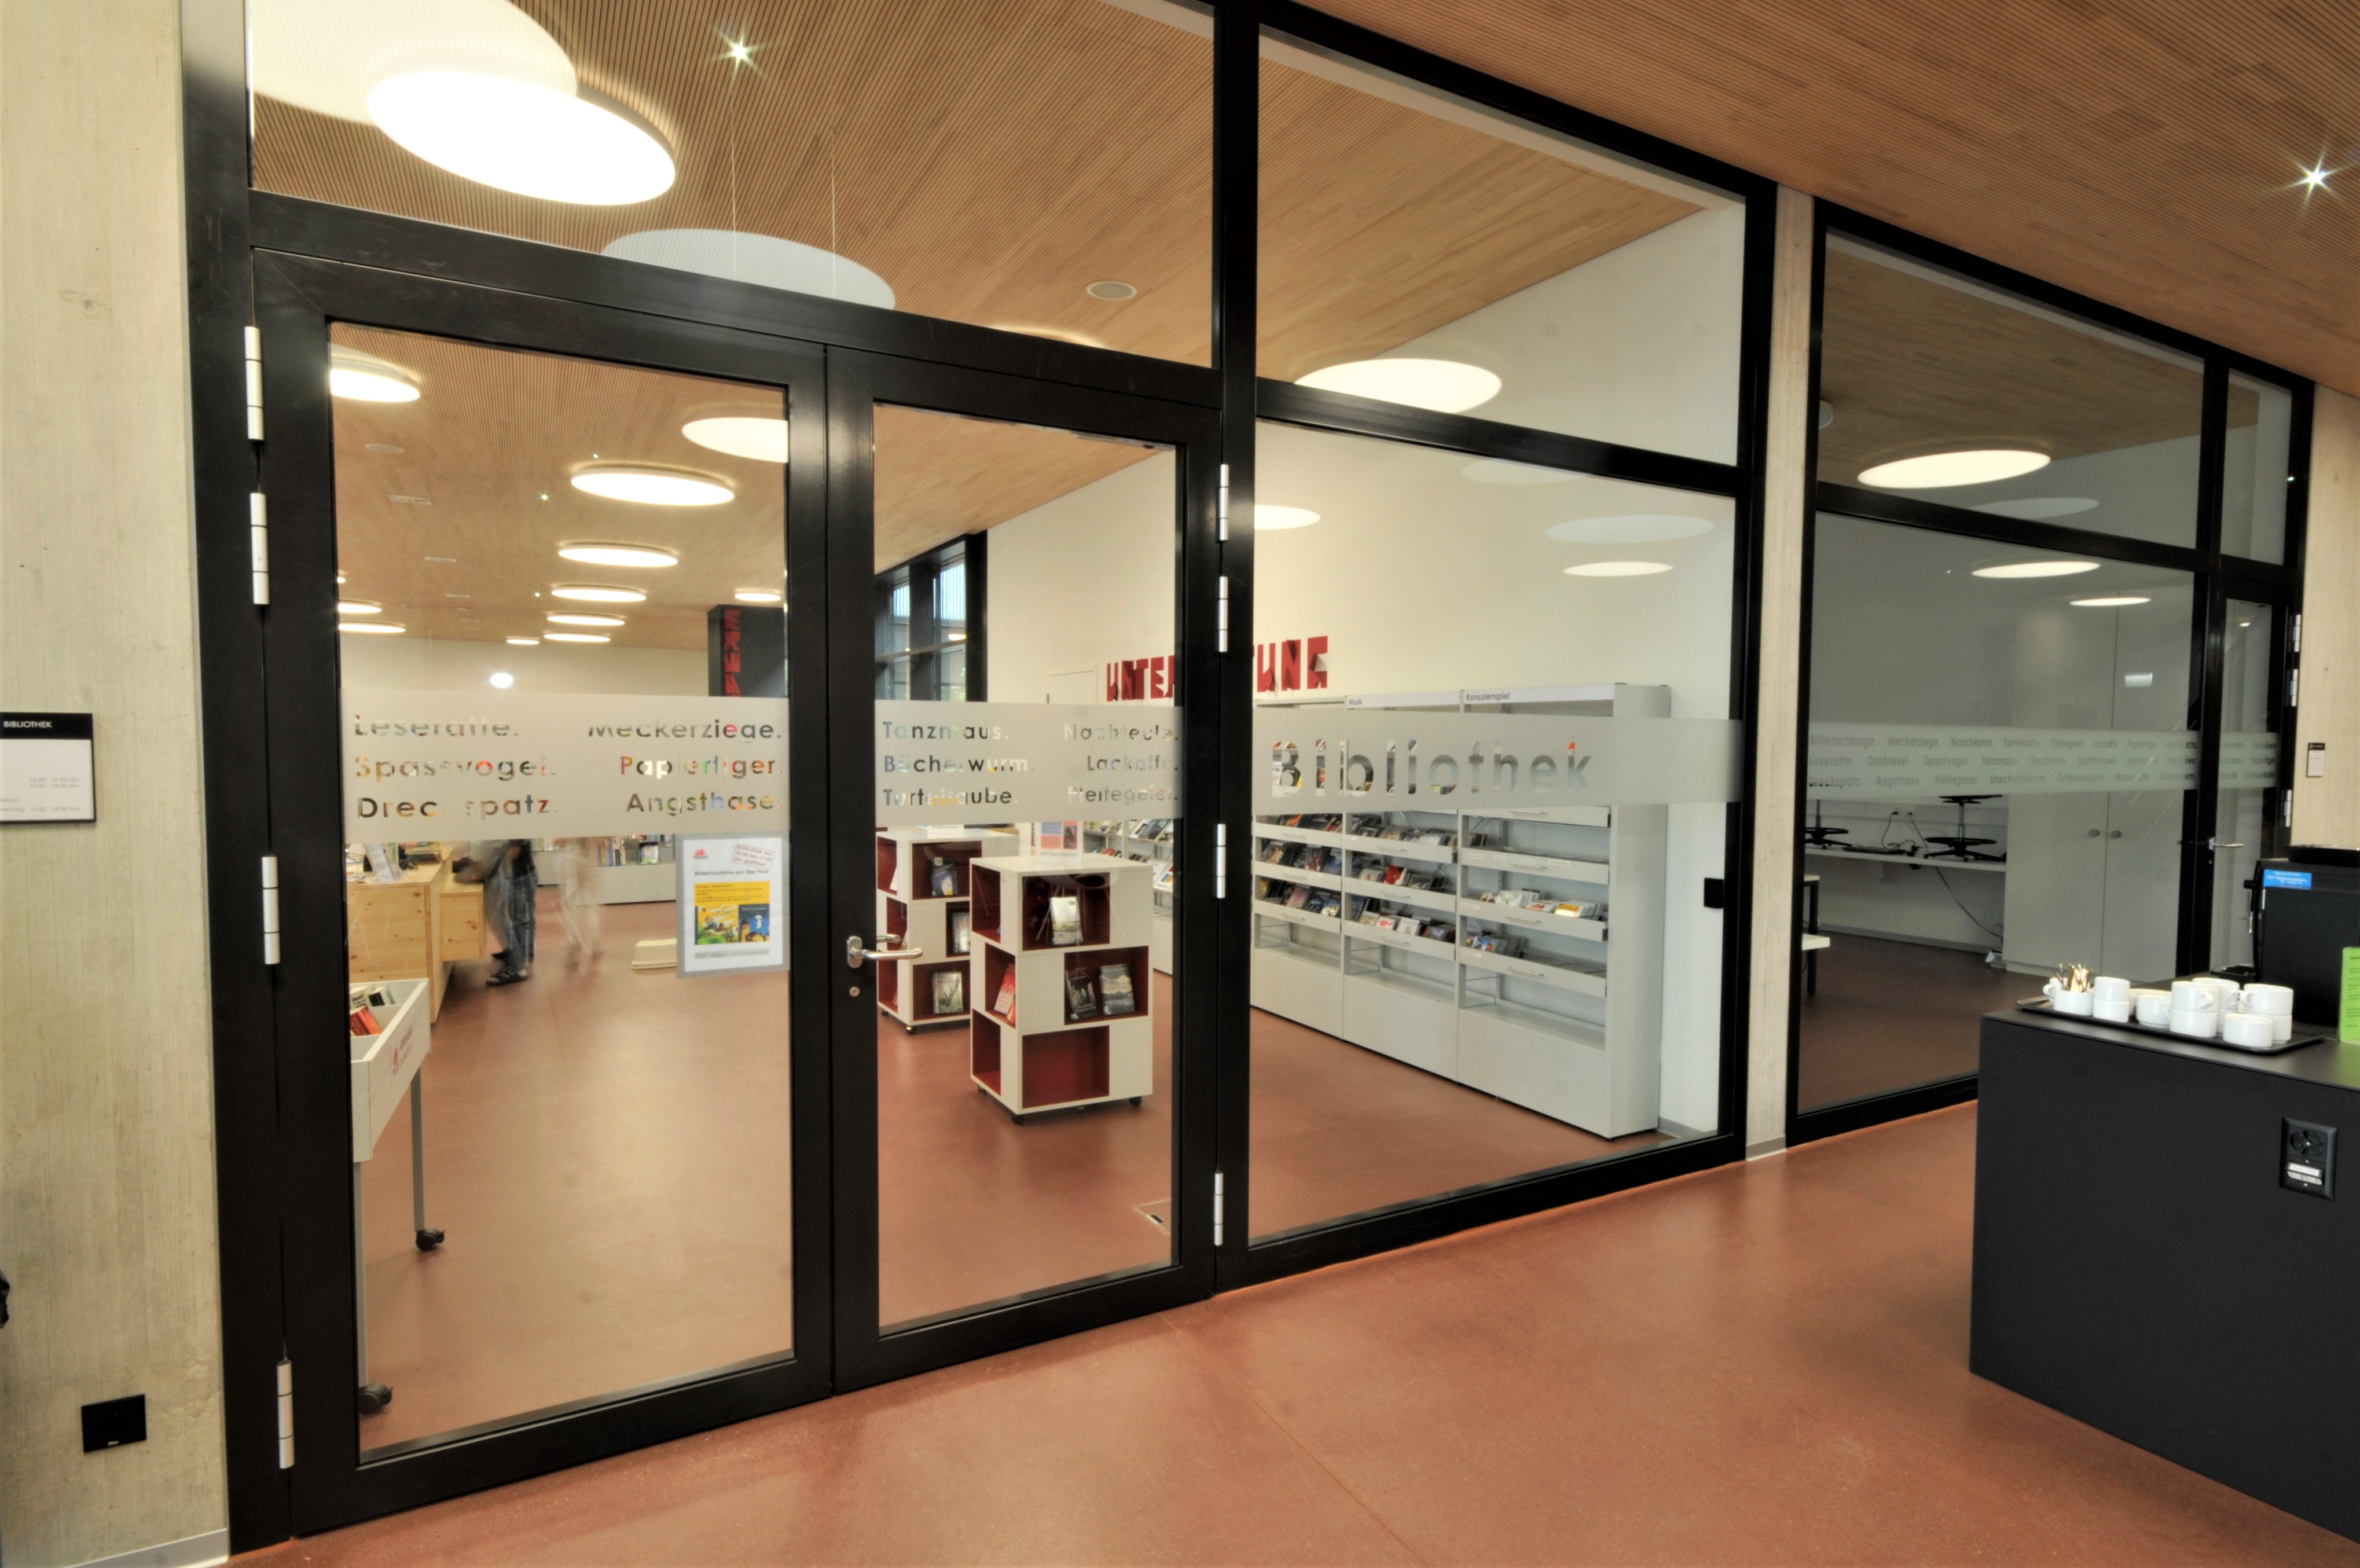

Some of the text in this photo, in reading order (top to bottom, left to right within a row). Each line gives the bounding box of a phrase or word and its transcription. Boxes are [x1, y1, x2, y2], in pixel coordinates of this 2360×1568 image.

[1466, 692, 1510, 702] Konsolenspiel
[621, 756, 781, 779] Papertiger.
[1272, 739, 1592, 796] Bibliothek
[357, 792, 782, 820] Drecspatz. Angsthase.
